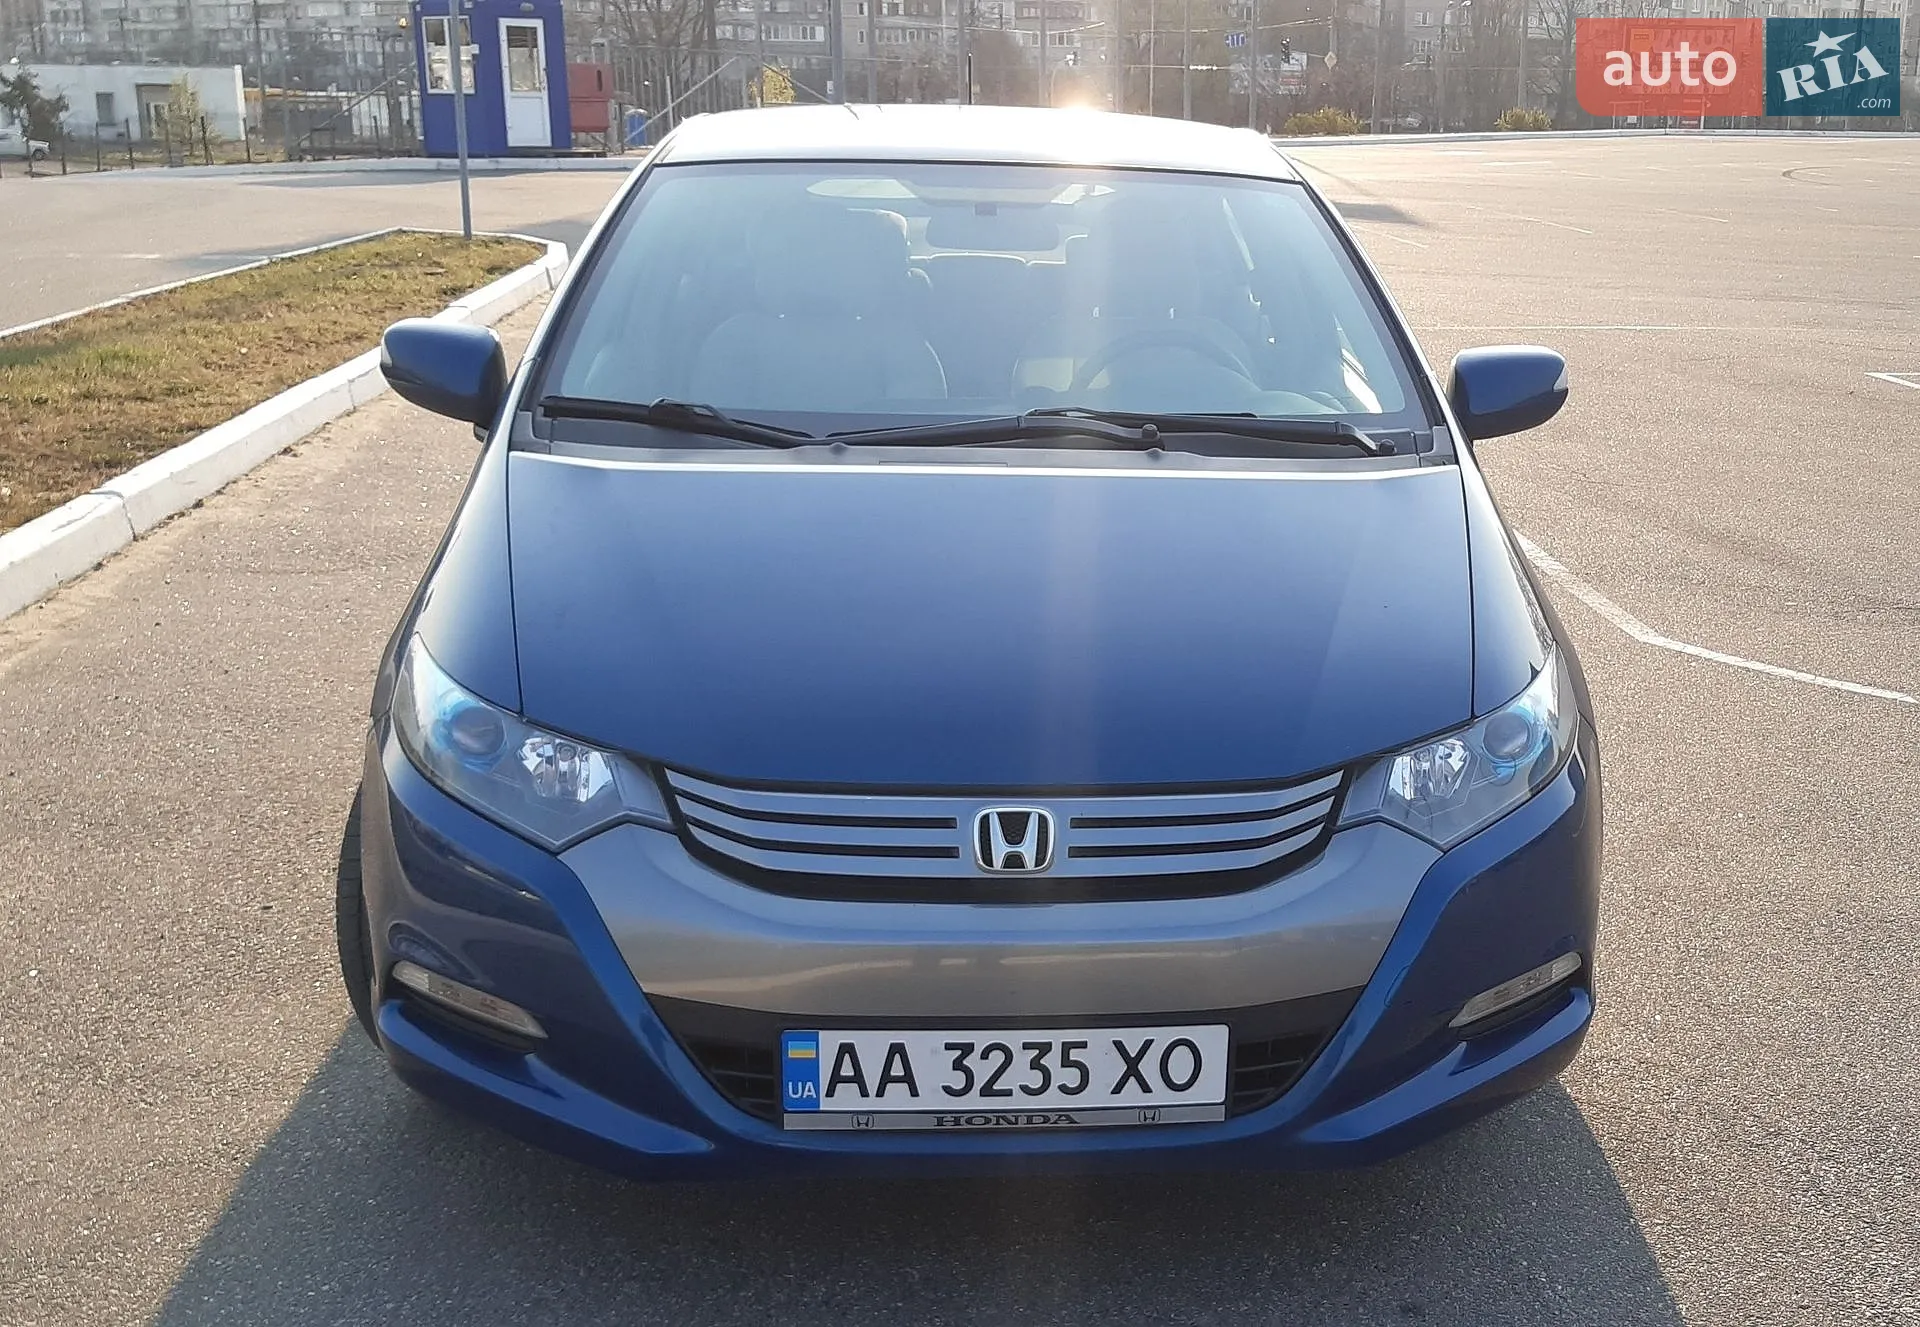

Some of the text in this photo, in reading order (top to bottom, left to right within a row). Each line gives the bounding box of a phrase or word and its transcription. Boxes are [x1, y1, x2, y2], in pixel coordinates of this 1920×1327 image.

[824, 1037, 1203, 1099] AA 3235 XO
[787, 1081, 818, 1099] UA
[933, 1113, 1081, 1127] HONDA
